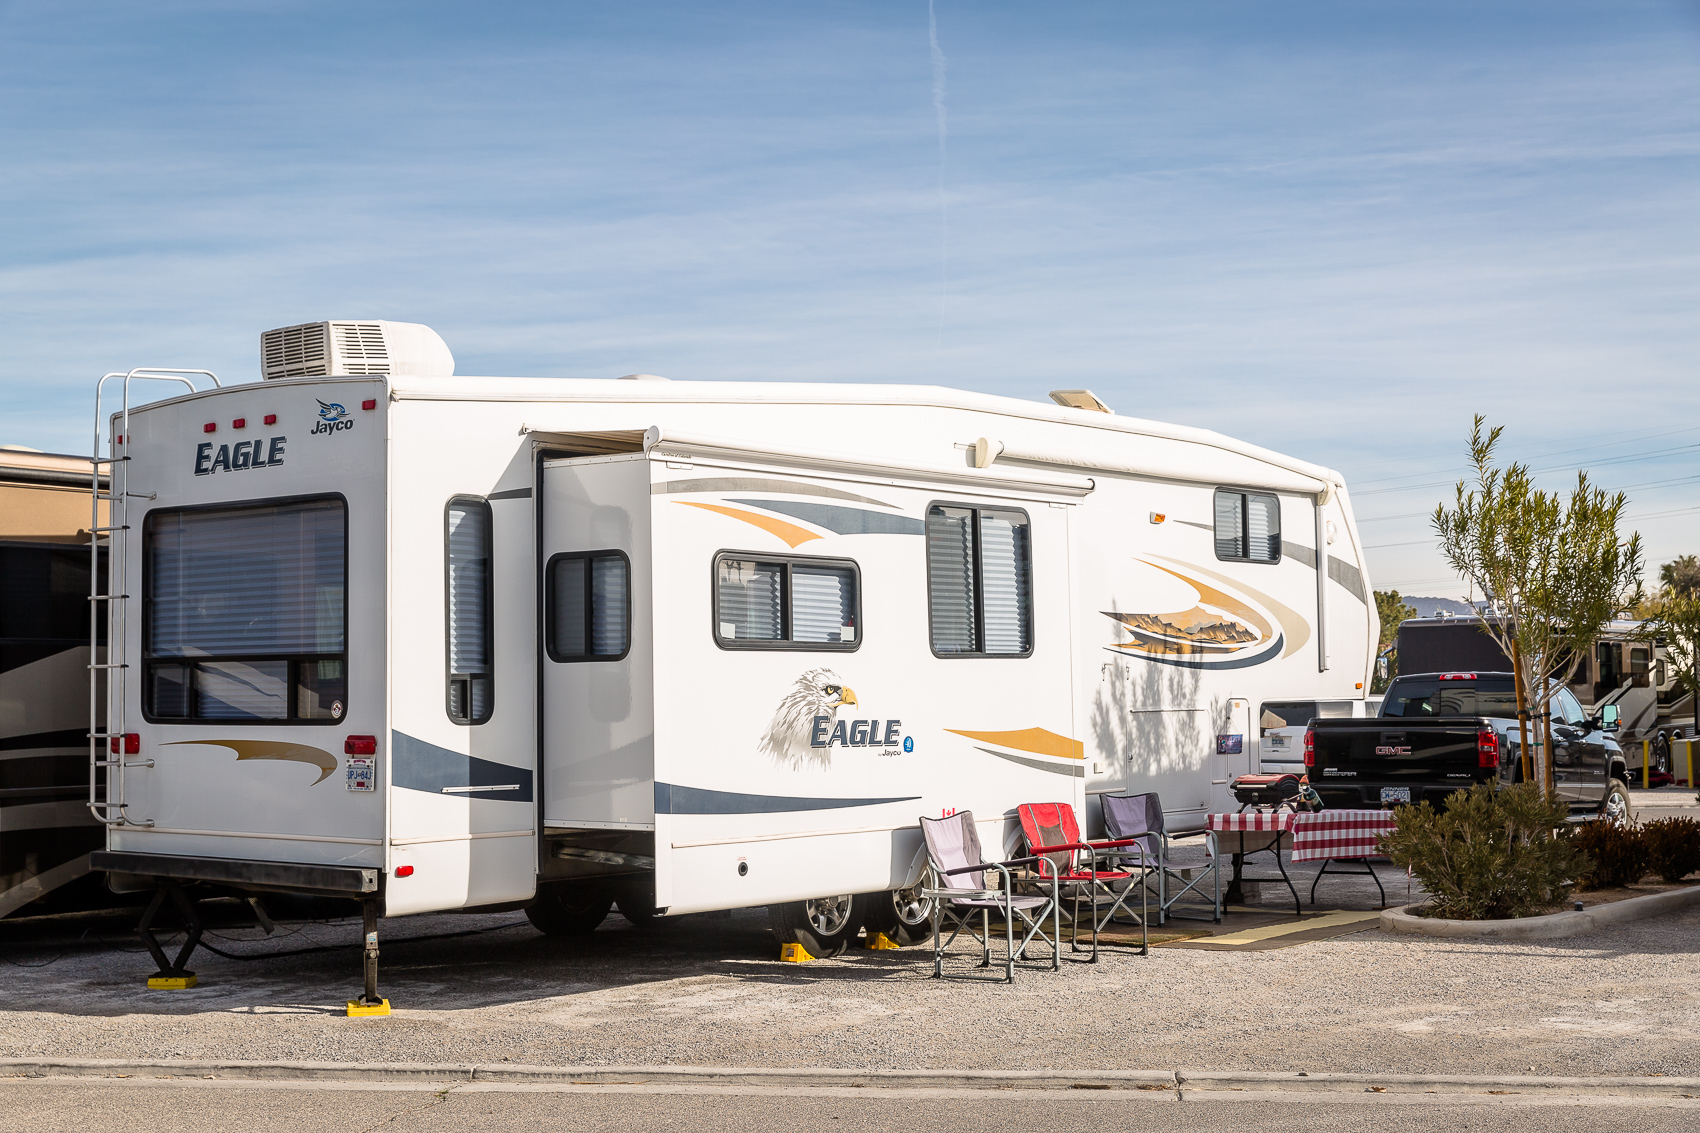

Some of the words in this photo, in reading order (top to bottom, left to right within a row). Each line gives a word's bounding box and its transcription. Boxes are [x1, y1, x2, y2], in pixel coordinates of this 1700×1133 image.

[310, 419, 354, 435] Jayco
[194, 436, 287, 476] EAGLE
[810, 715, 902, 748] EAGLE
[882, 749, 902, 757] Jayco
[1375, 746, 1412, 755] GMC
